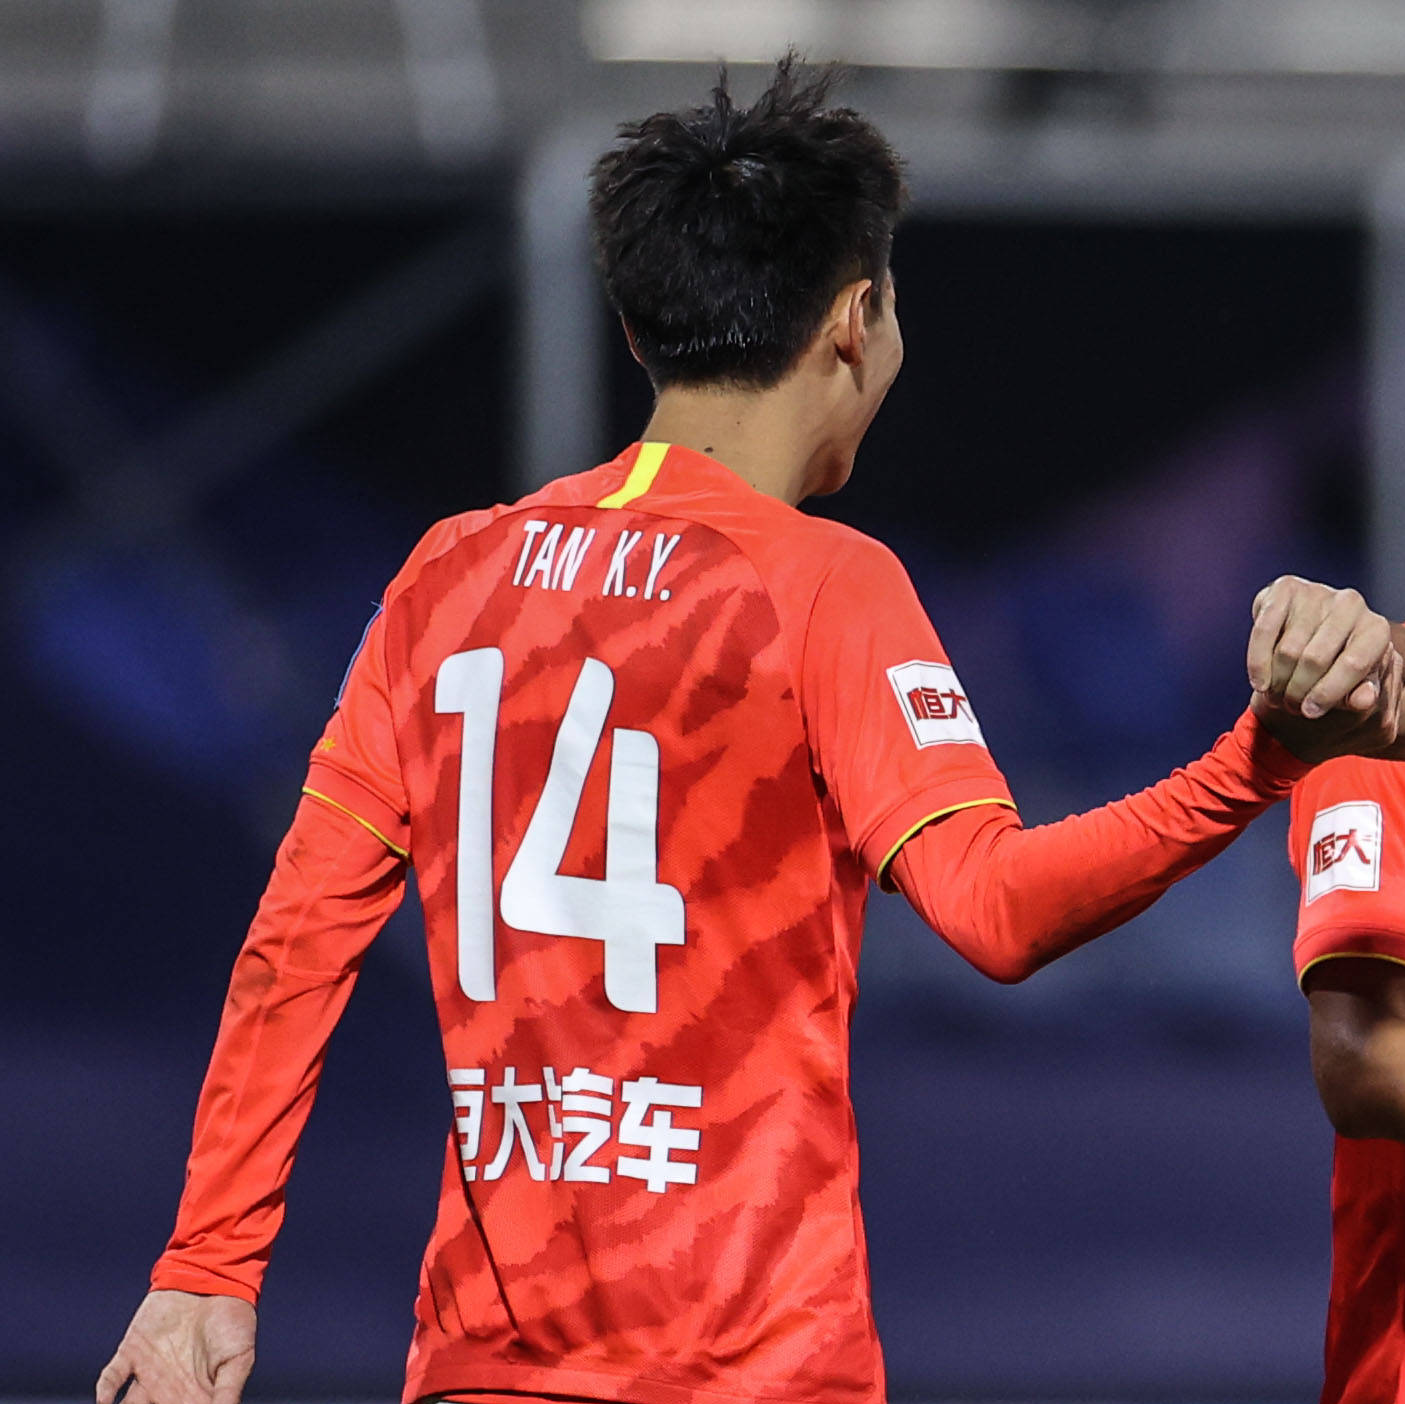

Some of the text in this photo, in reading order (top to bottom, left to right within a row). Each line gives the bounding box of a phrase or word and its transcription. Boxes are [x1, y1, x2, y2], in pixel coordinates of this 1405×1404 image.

[512, 519, 681, 601] TAN K.Y.
[907, 687, 974, 723] 恒大
[434, 646, 686, 1014] 14
[1312, 829, 1371, 876] 恒大
